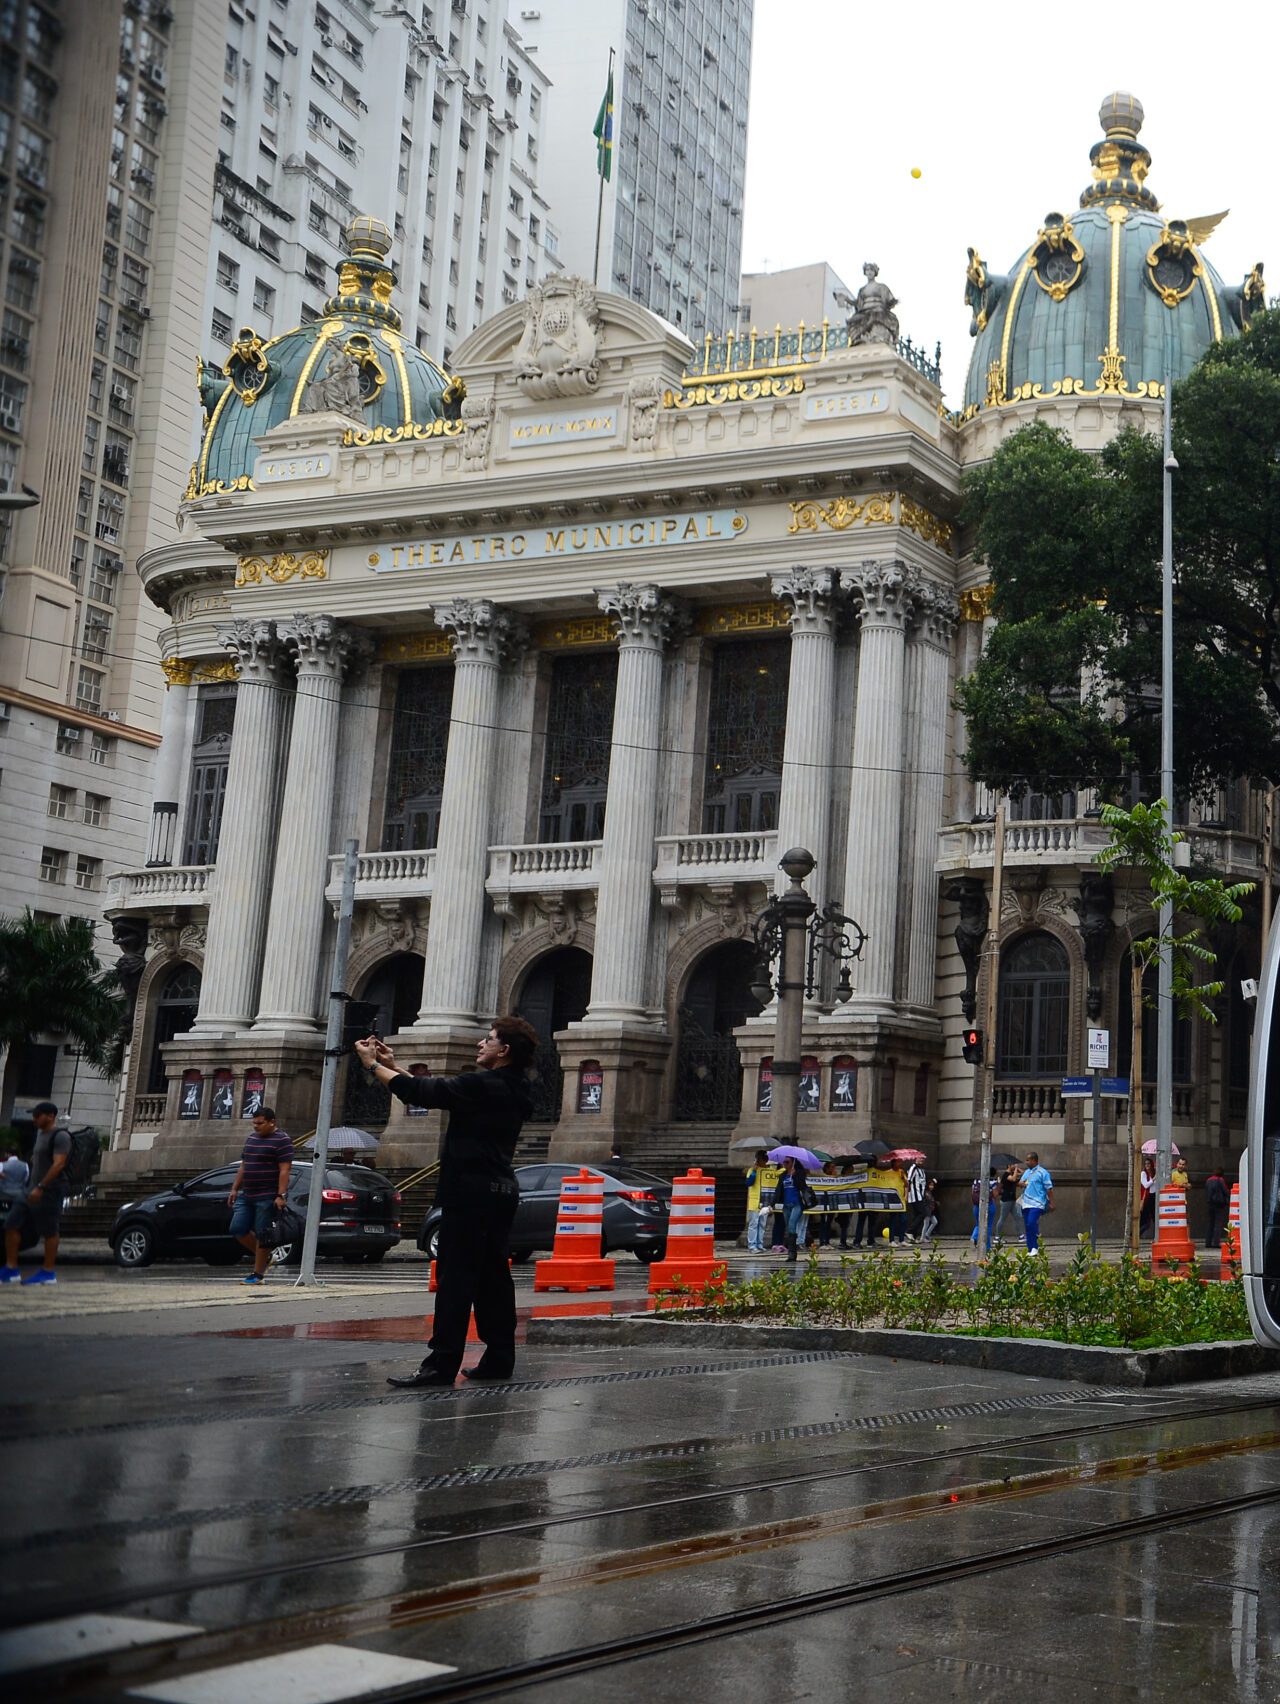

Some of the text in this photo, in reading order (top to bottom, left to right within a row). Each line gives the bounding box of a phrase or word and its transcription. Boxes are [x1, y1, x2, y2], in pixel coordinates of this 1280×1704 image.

[815, 393, 879, 414] POESIA
[391, 515, 721, 567] THEATRO MUNICIPAL
